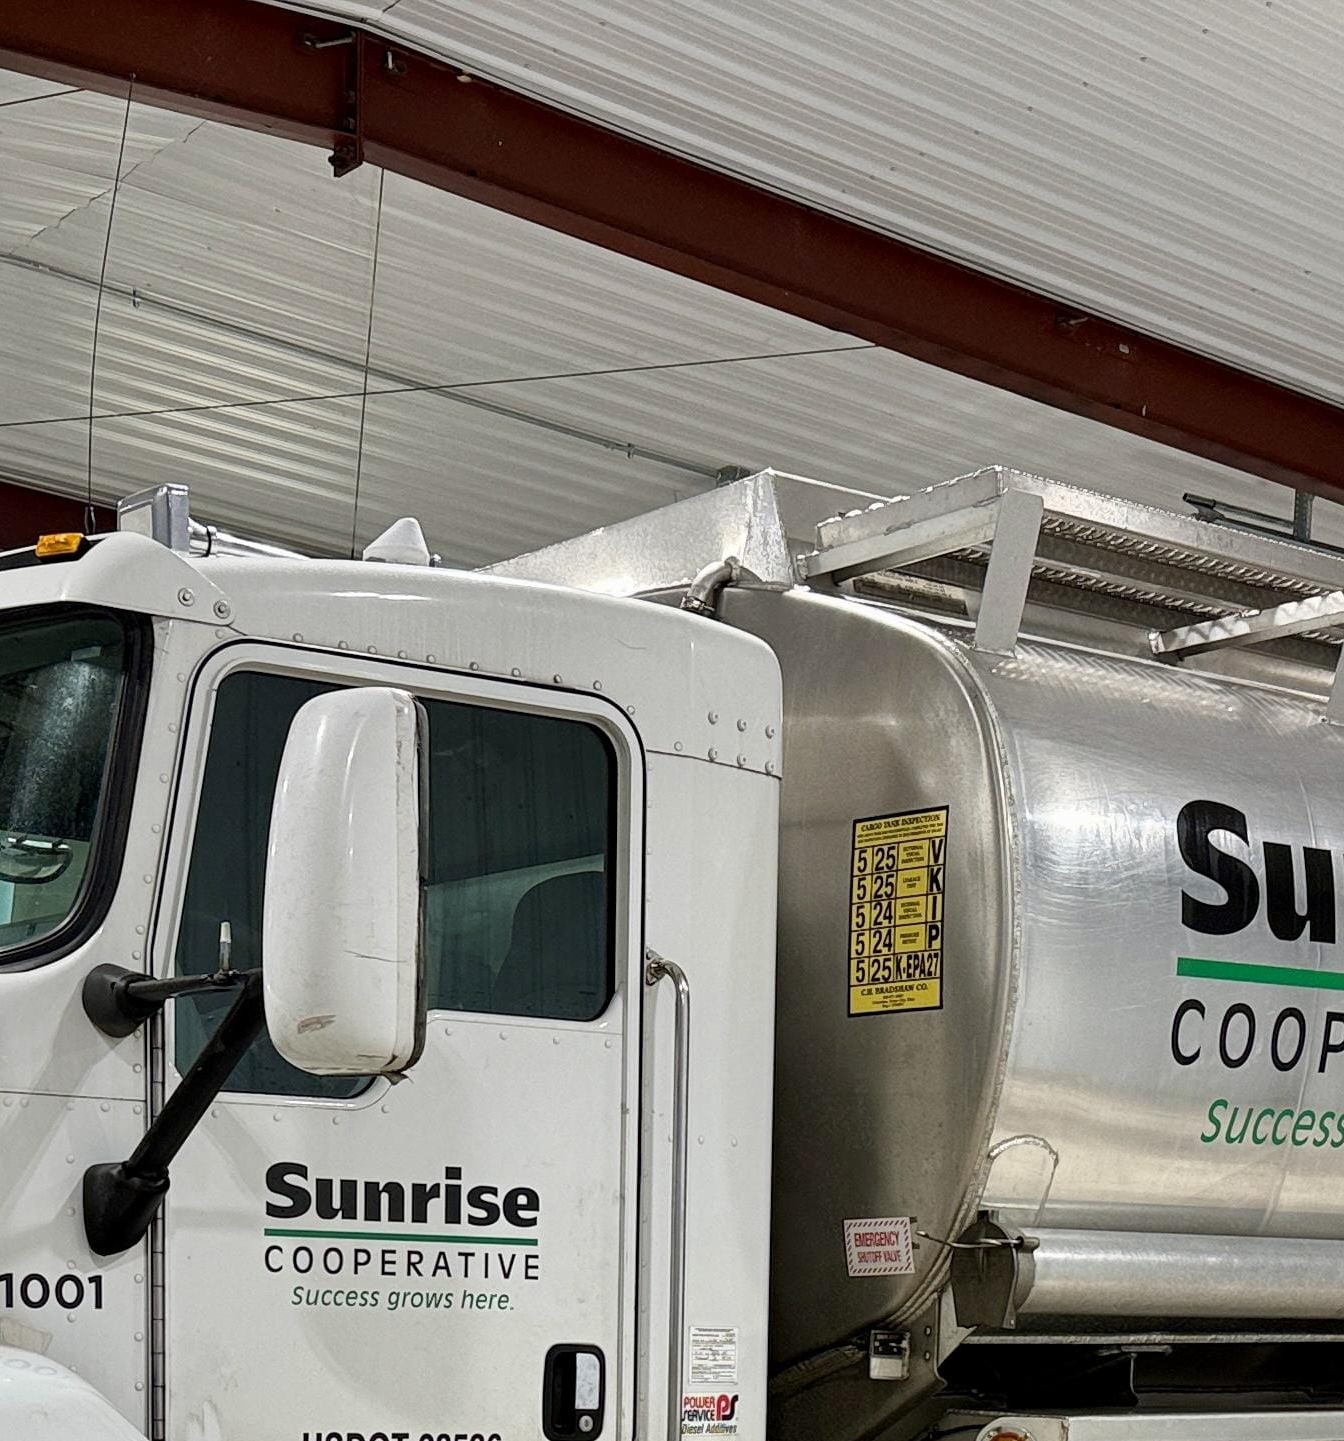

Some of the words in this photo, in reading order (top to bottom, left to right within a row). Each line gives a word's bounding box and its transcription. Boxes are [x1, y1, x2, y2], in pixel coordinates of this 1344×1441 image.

[857, 849, 867, 873] 5
[874, 846, 896, 872] 25
[931, 838, 944, 864] V
[857, 877, 867, 901] 5
[873, 873, 895, 899] 25
[929, 867, 942, 892] K
[856, 905, 866, 928] 5
[873, 900, 893, 926] 24
[931, 895, 938, 921] I
[855, 932, 866, 956] 5
[872, 928, 893, 954] 24
[928, 924, 940, 949] P
[855, 959, 866, 983] 5
[871, 957, 892, 982] 25
[265, 1162, 540, 1228] Sunrise
[264, 1244, 540, 1281] COOPERATIVE
[292, 1286, 380, 1309] Success
[386, 1290, 454, 1312] grows
[460, 1289, 515, 1311] here.
[682, 1409, 716, 1422] SERVICE
[683, 1396, 716, 1408] POWER
